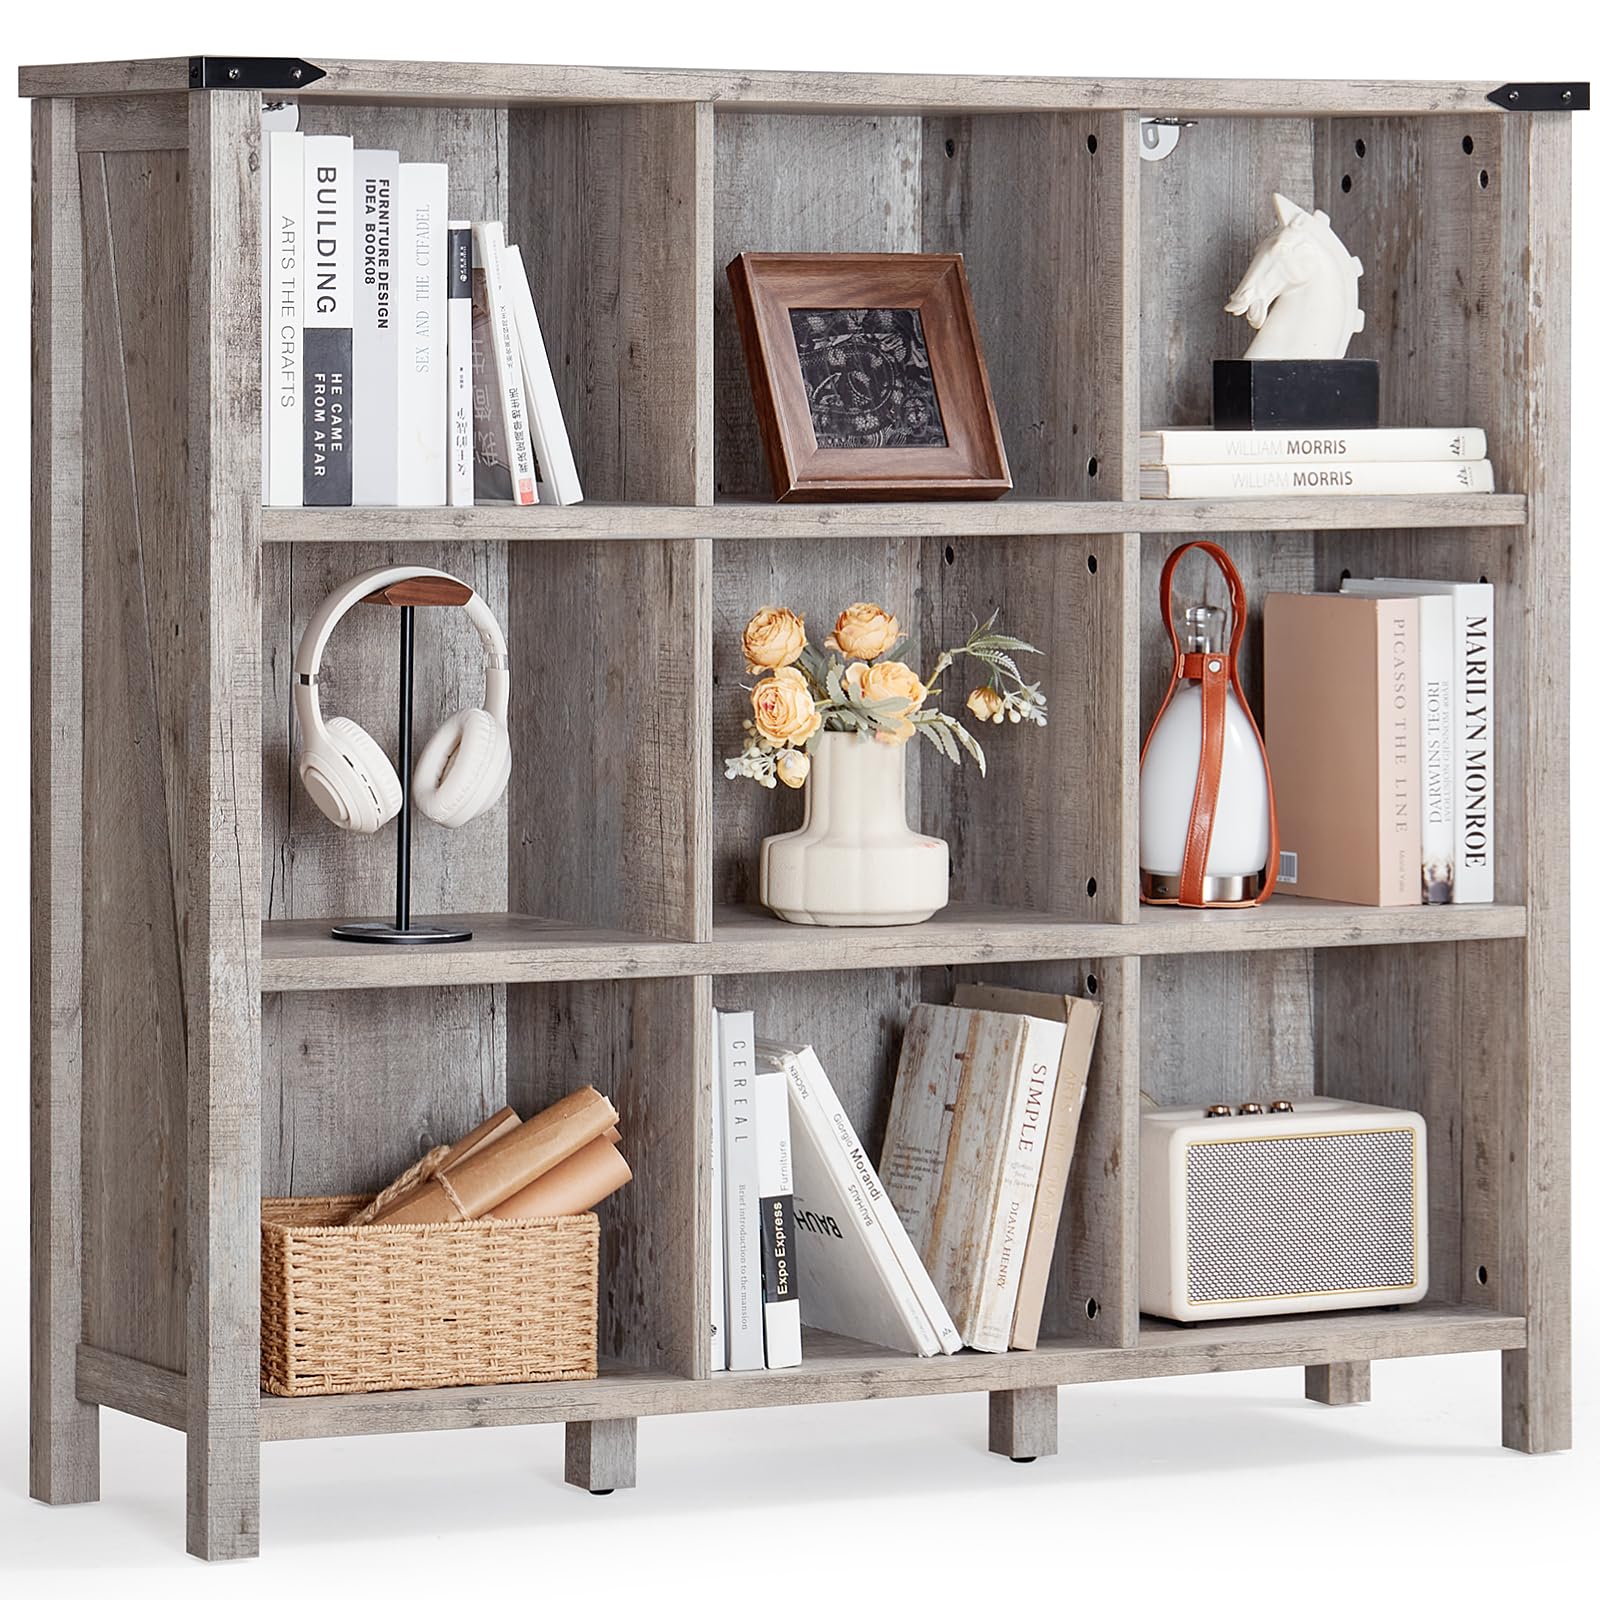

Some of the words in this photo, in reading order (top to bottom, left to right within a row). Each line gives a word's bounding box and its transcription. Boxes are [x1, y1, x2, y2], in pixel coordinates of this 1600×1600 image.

[365, 179, 376, 214] IDEA
[281, 216, 296, 269] ARTS
[316, 167, 337, 313] BUILDING
[379, 179, 390, 268] FURNITURE
[364, 223, 376, 285] BOOK08
[281, 278, 295, 317] THE
[378, 270, 389, 329] DESIGN
[416, 275, 430, 302] THE
[416, 310, 430, 337] AND
[281, 325, 296, 408] CRAFTS
[330, 374, 343, 394] HE
[416, 346, 430, 373] SEX
[314, 374, 326, 422] FROM
[331, 403, 343, 452] CAME
[1226, 440, 1284, 456] WILLIAM
[1286, 440, 1347, 455] MORRIS
[314, 431, 325, 477] AFAR
[1232, 472, 1290, 488] WILLIAM
[1293, 471, 1353, 487] MORRIS
[1393, 619, 1407, 710] PICASSO
[1465, 616, 1487, 740] MARILYN
[1427, 681, 1441, 734] TEORI
[1395, 719, 1407, 765] THE
[1396, 778, 1408, 833] LINE
[1428, 739, 1442, 823] DARWINS
[1465, 750, 1487, 868] MONROE
[733, 1041, 748, 1143] CEREAL
[790, 1065, 809, 1100] TASCHEN
[1018, 1063, 1047, 1152] SIMPLE
[779, 1140, 789, 1192] Furniture
[833, 1113, 853, 1148] Giorgio
[850, 1148, 883, 1202] Morandi
[773, 1201, 787, 1258] Express
[848, 1184, 874, 1227] BAUHAUS
[1005, 1201, 1020, 1244] DIANA
[739, 1207, 747, 1263] introduction
[740, 1276, 748, 1290] the
[777, 1260, 788, 1295] Expo
[996, 1246, 1012, 1290] HENRY
